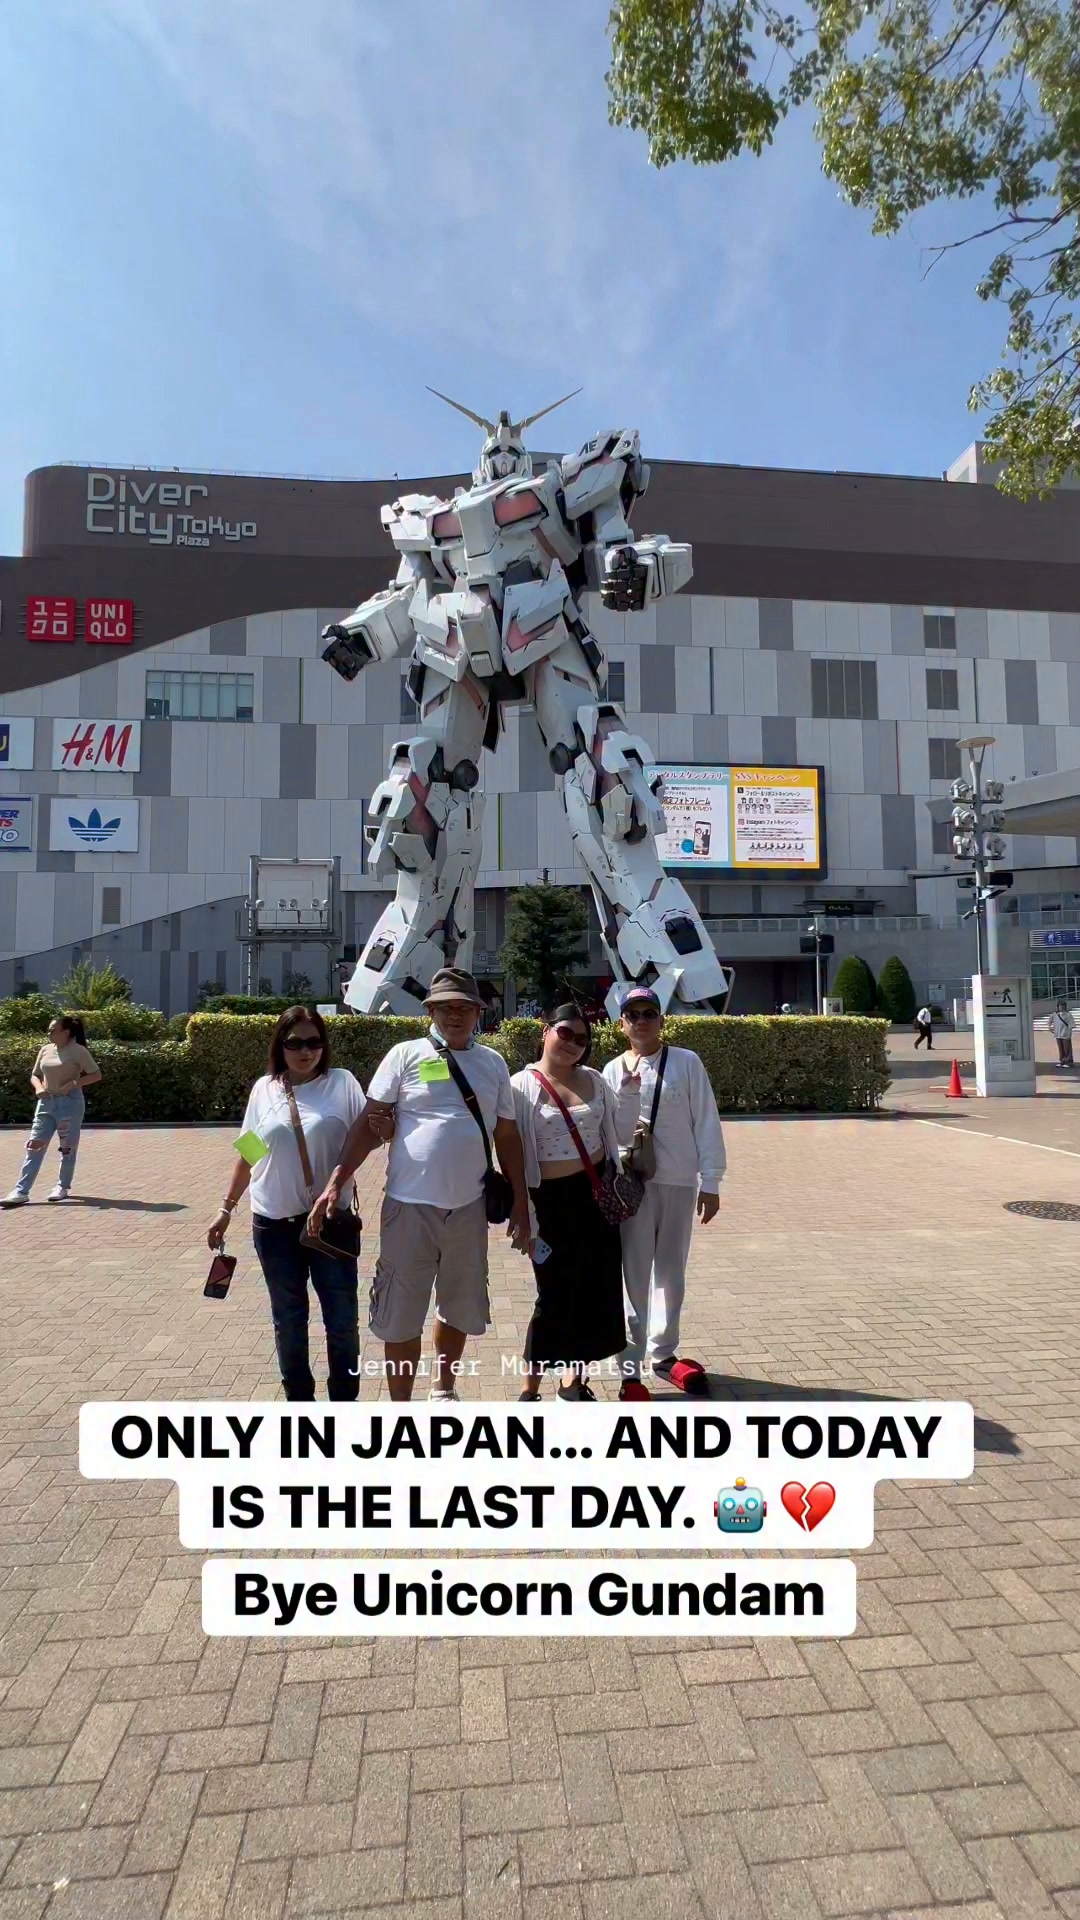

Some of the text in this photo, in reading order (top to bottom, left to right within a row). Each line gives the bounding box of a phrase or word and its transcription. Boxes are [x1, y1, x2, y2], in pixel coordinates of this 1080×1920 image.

[87, 472, 208, 507] Diver
[86, 503, 174, 545] City
[176, 535, 210, 547] Plaza
[90, 603, 124, 619] UNI
[90, 621, 127, 639] QLO
[61, 723, 132, 768] H&M
